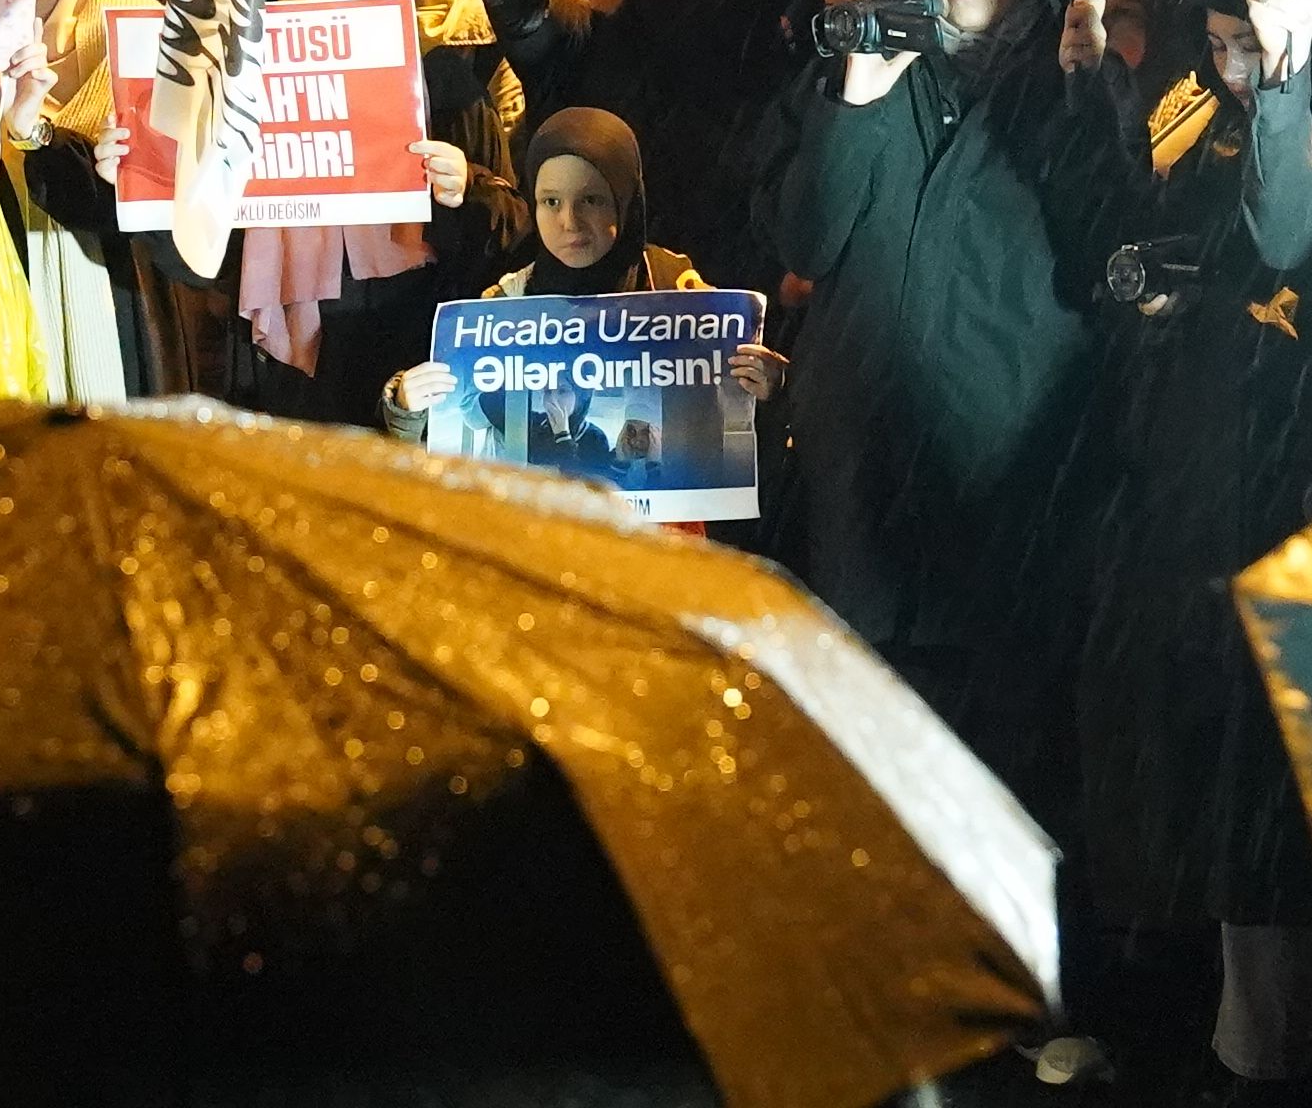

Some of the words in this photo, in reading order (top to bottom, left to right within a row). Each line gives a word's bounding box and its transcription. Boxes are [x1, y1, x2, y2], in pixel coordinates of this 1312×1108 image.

[263, 15, 352, 64] TÜSÜ
[453, 312, 585, 348] Hicaba
[598, 308, 745, 343] Uzanan
[472, 355, 566, 393] Əllər
[572, 349, 722, 391] Qırılsın!
